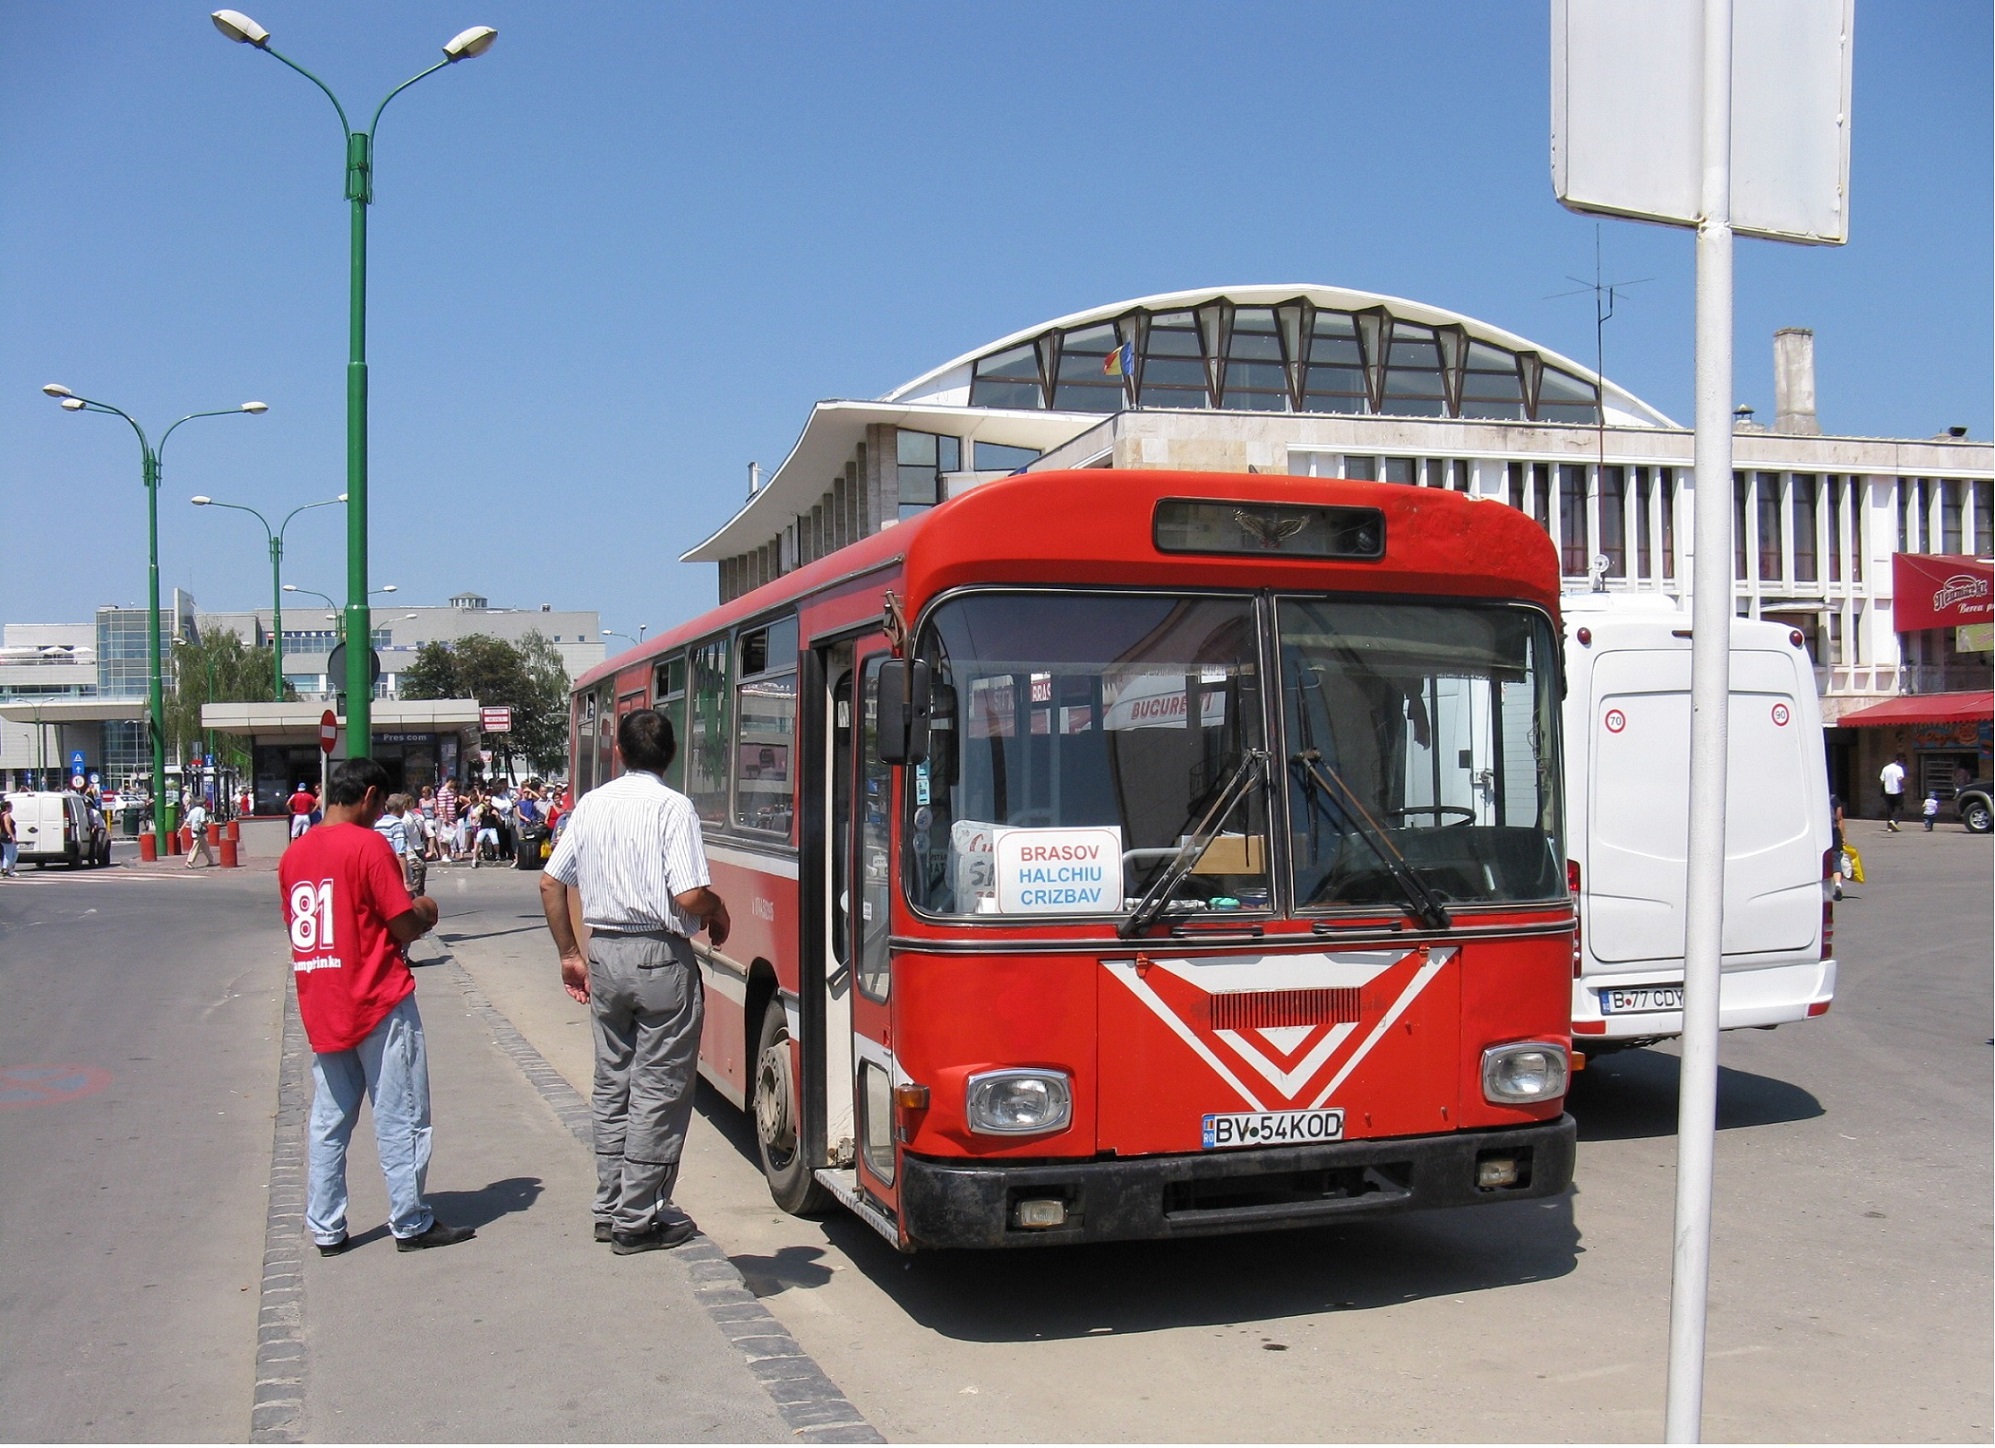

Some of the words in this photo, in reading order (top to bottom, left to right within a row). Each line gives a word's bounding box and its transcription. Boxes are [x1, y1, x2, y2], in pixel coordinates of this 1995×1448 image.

[1610, 716, 1621, 727] 70
[1775, 709, 1786, 720] 90
[383, 733, 404, 741] Pres
[1020, 845, 1100, 862] BRASOV
[1019, 866, 1102, 884] HALCHIU
[1020, 888, 1102, 906] CRIZBAV
[290, 878, 335, 953] 81
